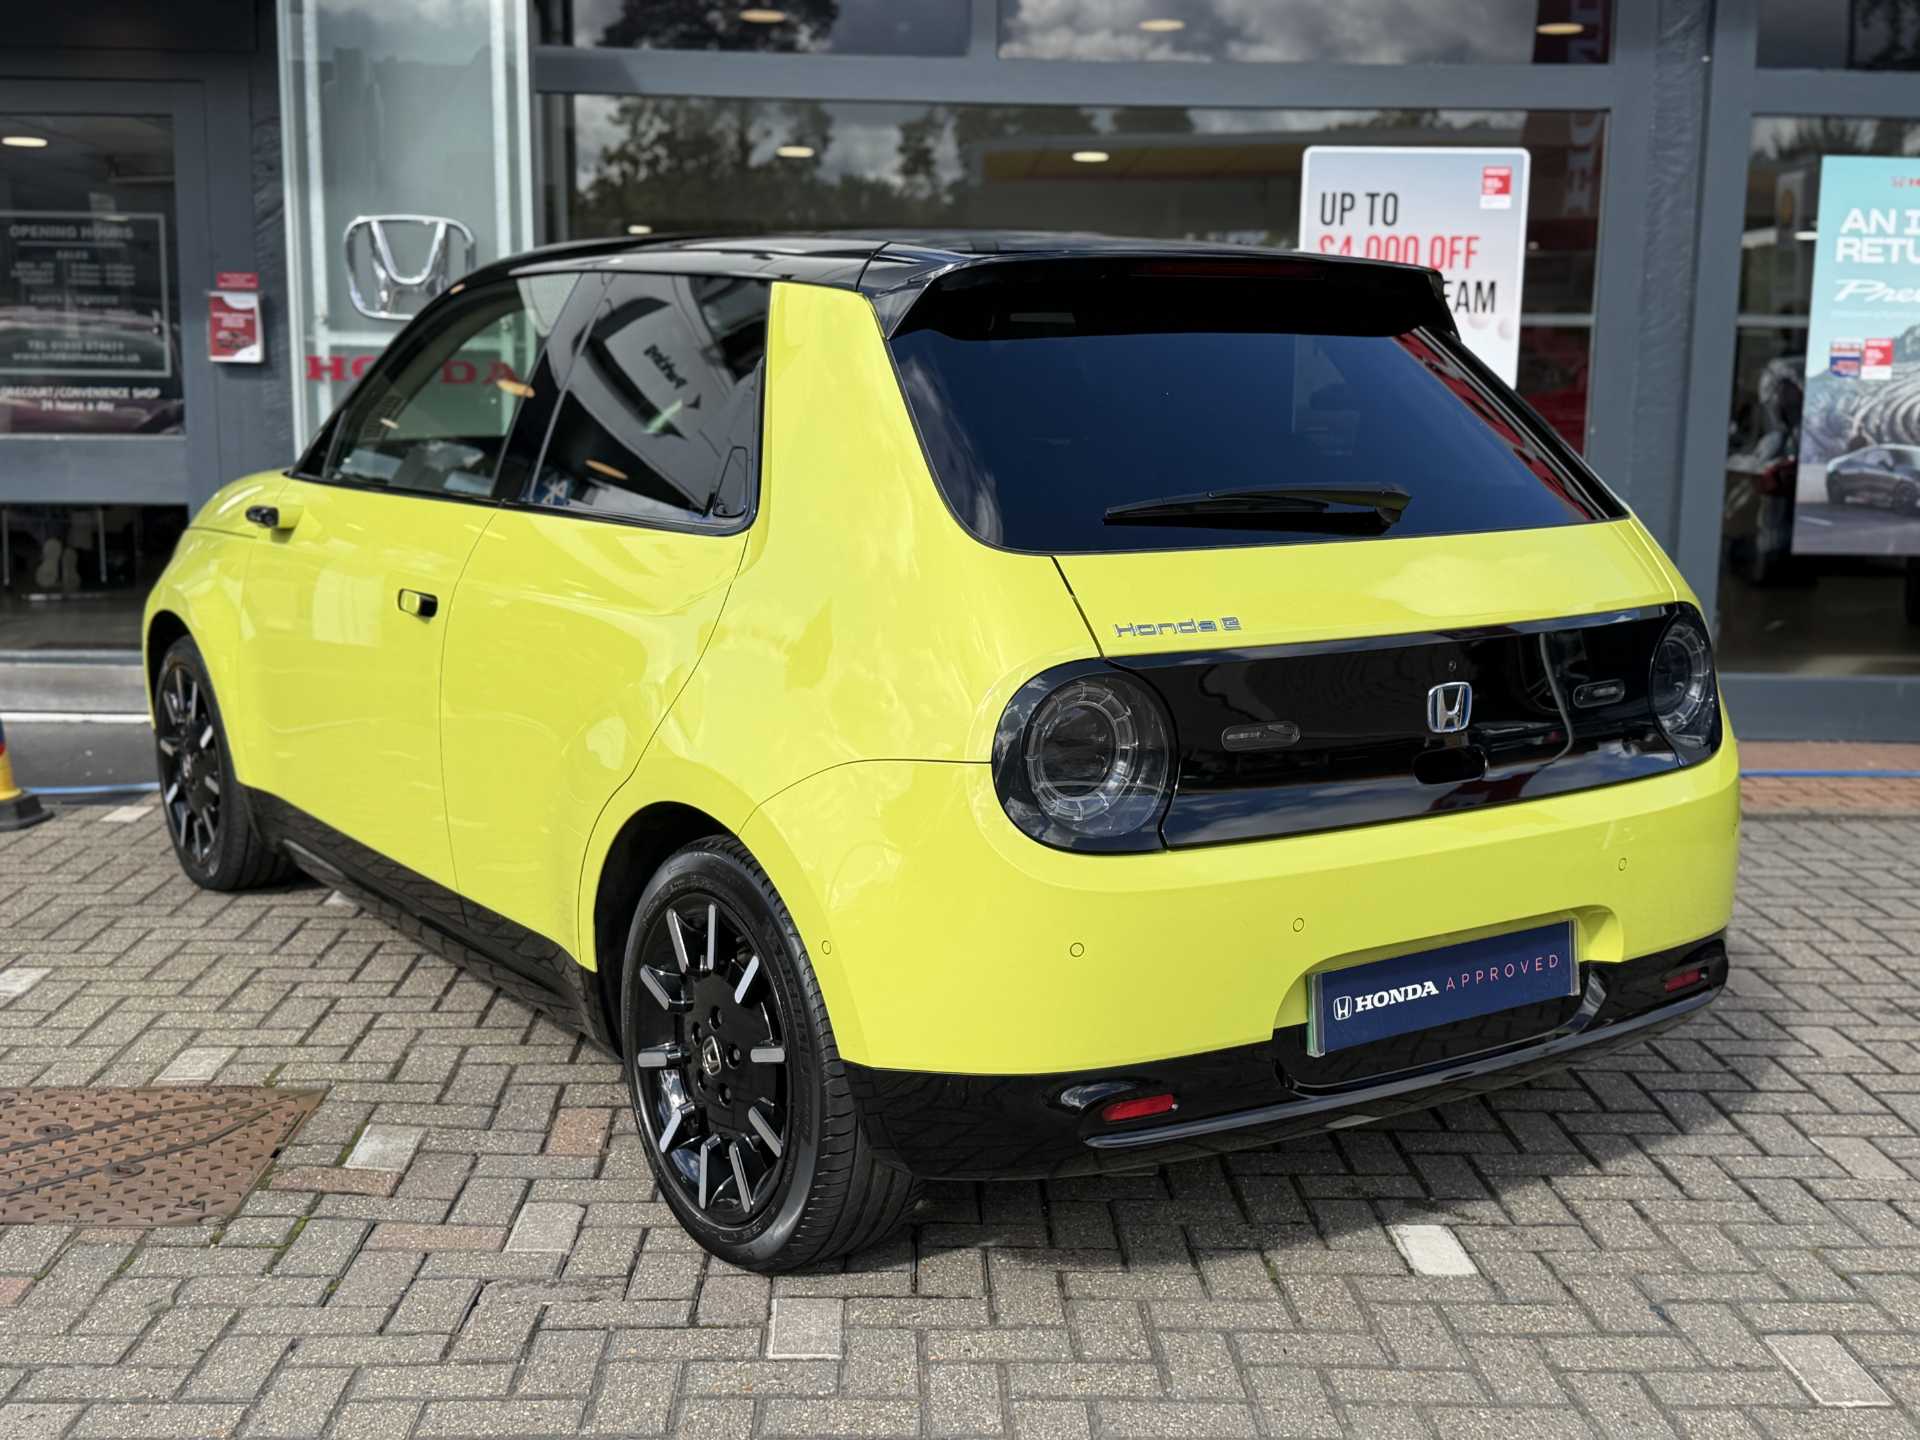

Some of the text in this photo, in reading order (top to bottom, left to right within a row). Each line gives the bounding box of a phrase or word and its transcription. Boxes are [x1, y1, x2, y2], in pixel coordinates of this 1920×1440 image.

[1320, 192, 1399, 226] UP TO
[1840, 208, 1897, 234] AN
[8, 224, 134, 240] OPENING HOURS
[1319, 234, 1480, 270] £4000 OFF
[1114, 618, 1217, 638] Honda
[1355, 953, 1560, 1014] HONDA APPROVED
